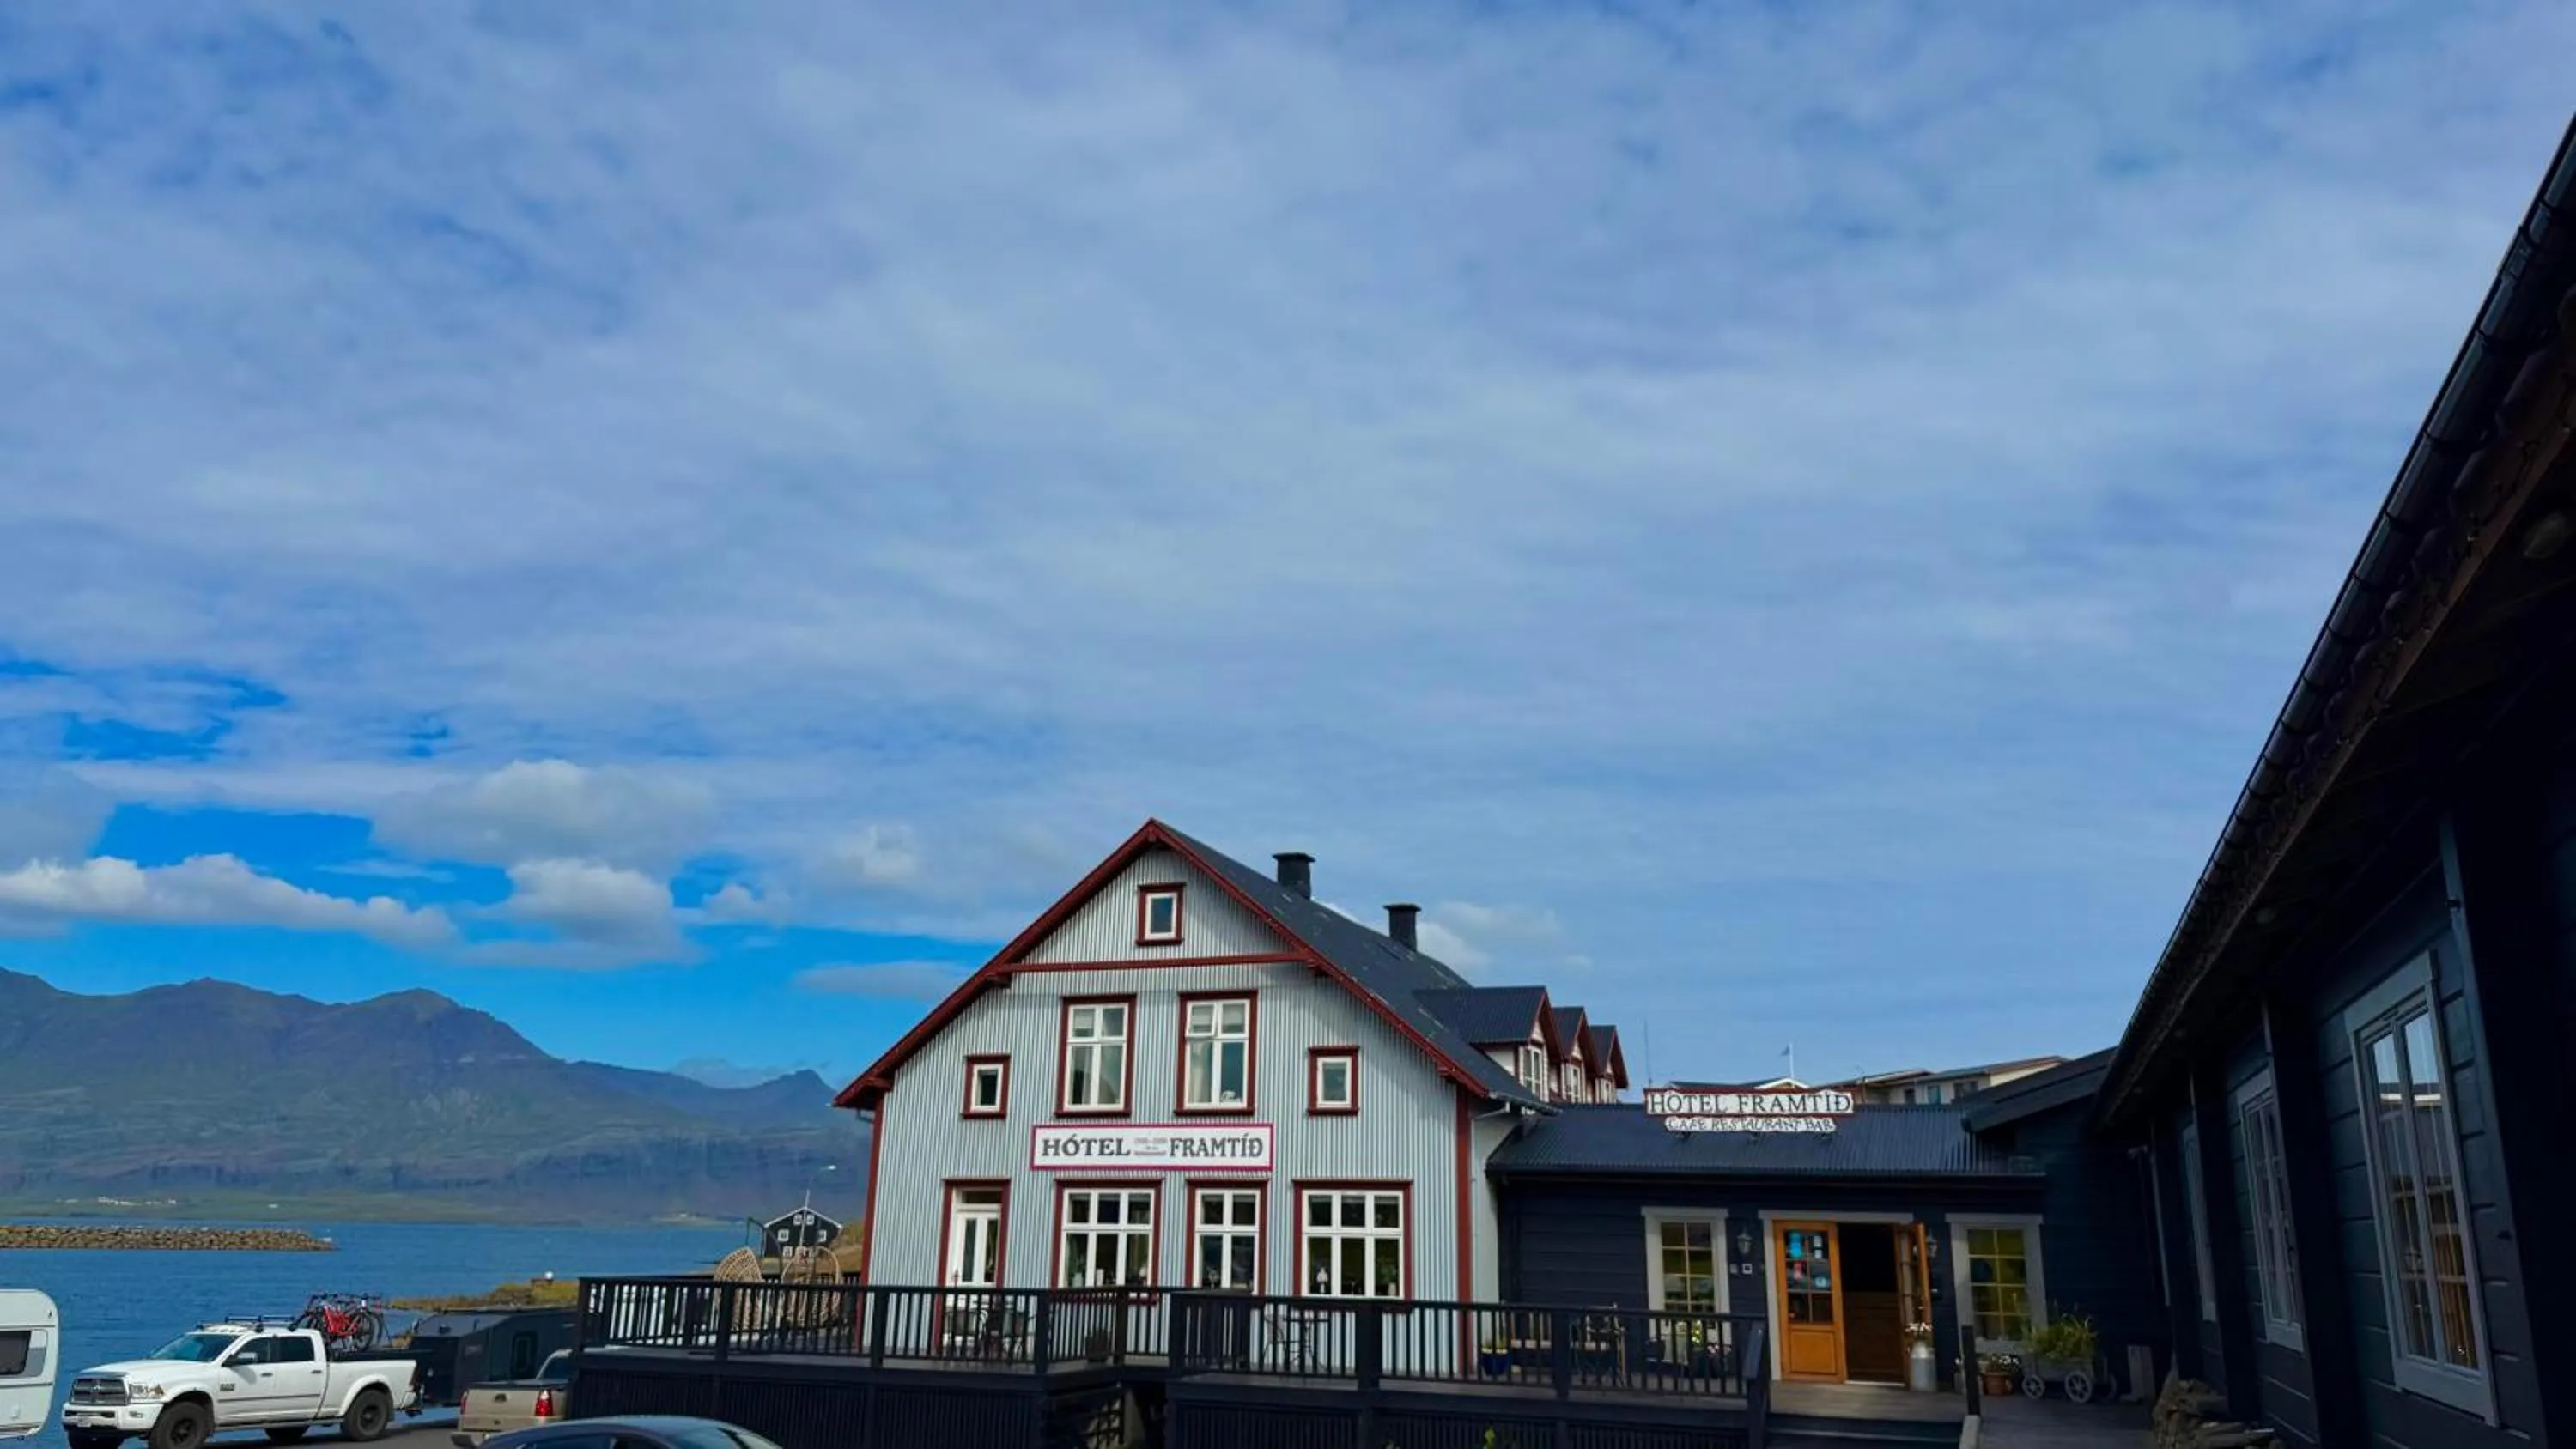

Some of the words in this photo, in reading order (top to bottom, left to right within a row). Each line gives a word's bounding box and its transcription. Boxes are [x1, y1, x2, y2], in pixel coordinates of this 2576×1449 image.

[1712, 1118, 1800, 1131] RESTAURANT
[1804, 1118, 1834, 1131] BAR
[1042, 1133, 1131, 1156] HÓTEL
[1170, 1132, 1263, 1157] FRAMTÍÐ
